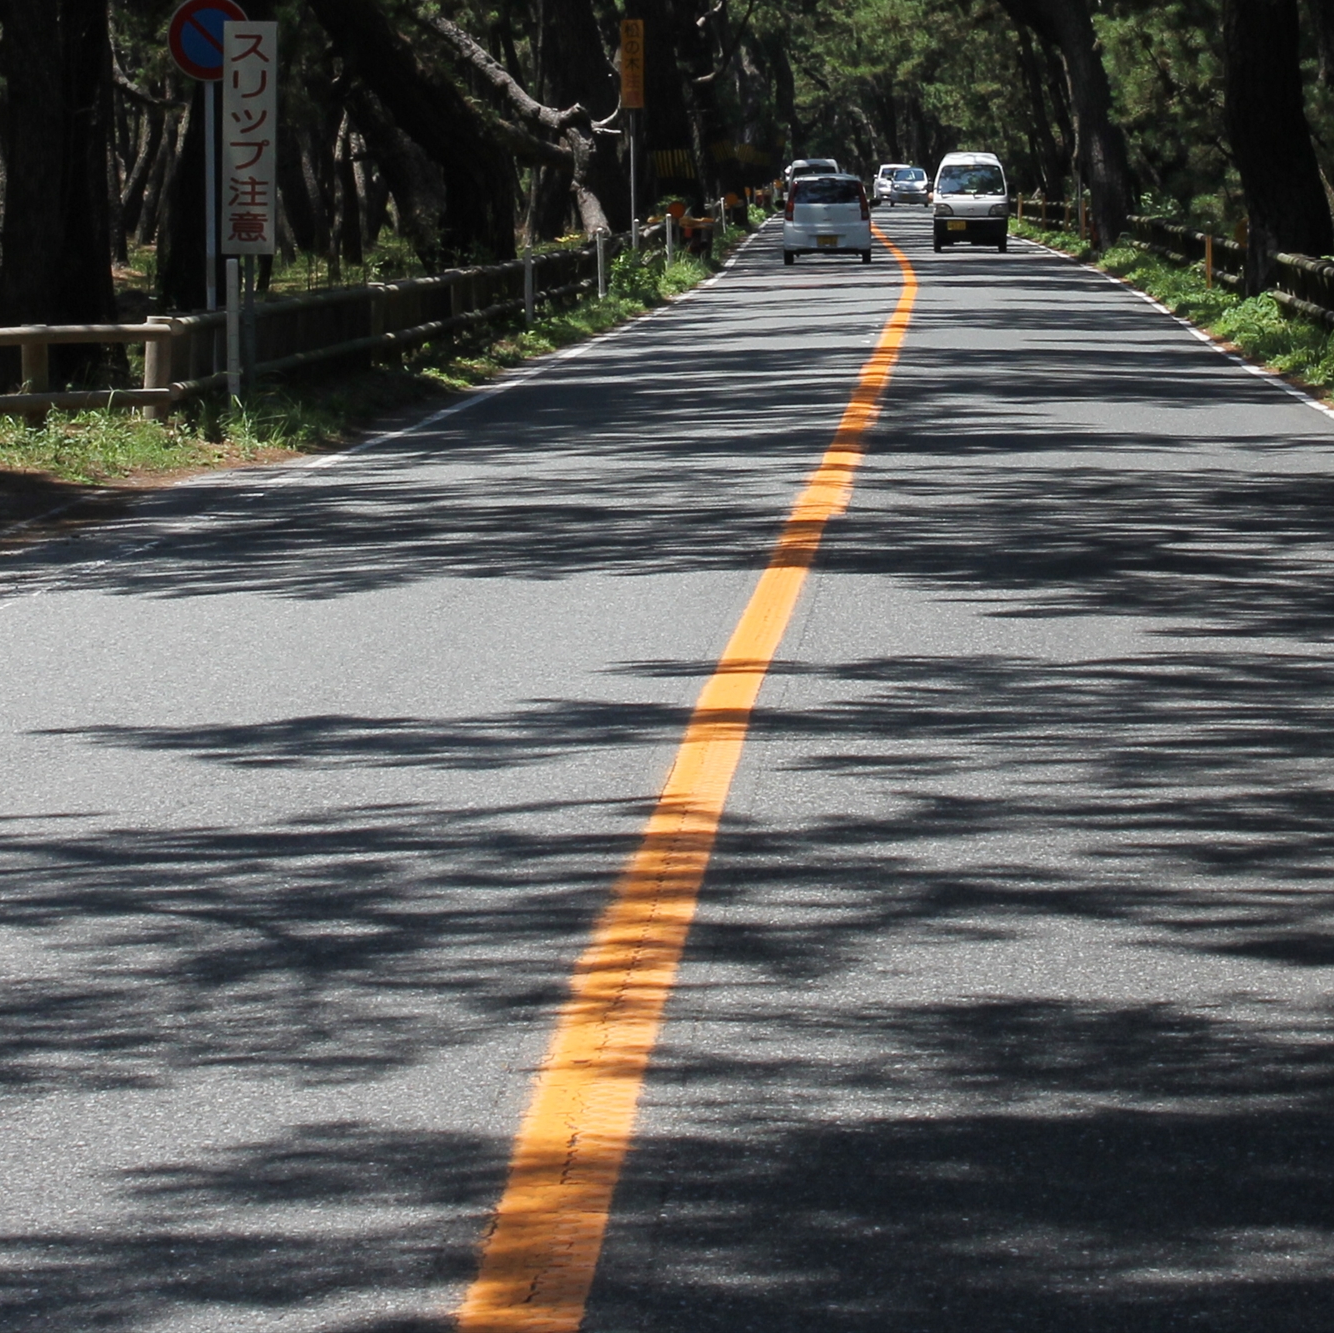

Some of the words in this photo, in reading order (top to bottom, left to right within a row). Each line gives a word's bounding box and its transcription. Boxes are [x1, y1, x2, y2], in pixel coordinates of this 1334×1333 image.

[228, 33, 270, 243] スリップ注意
